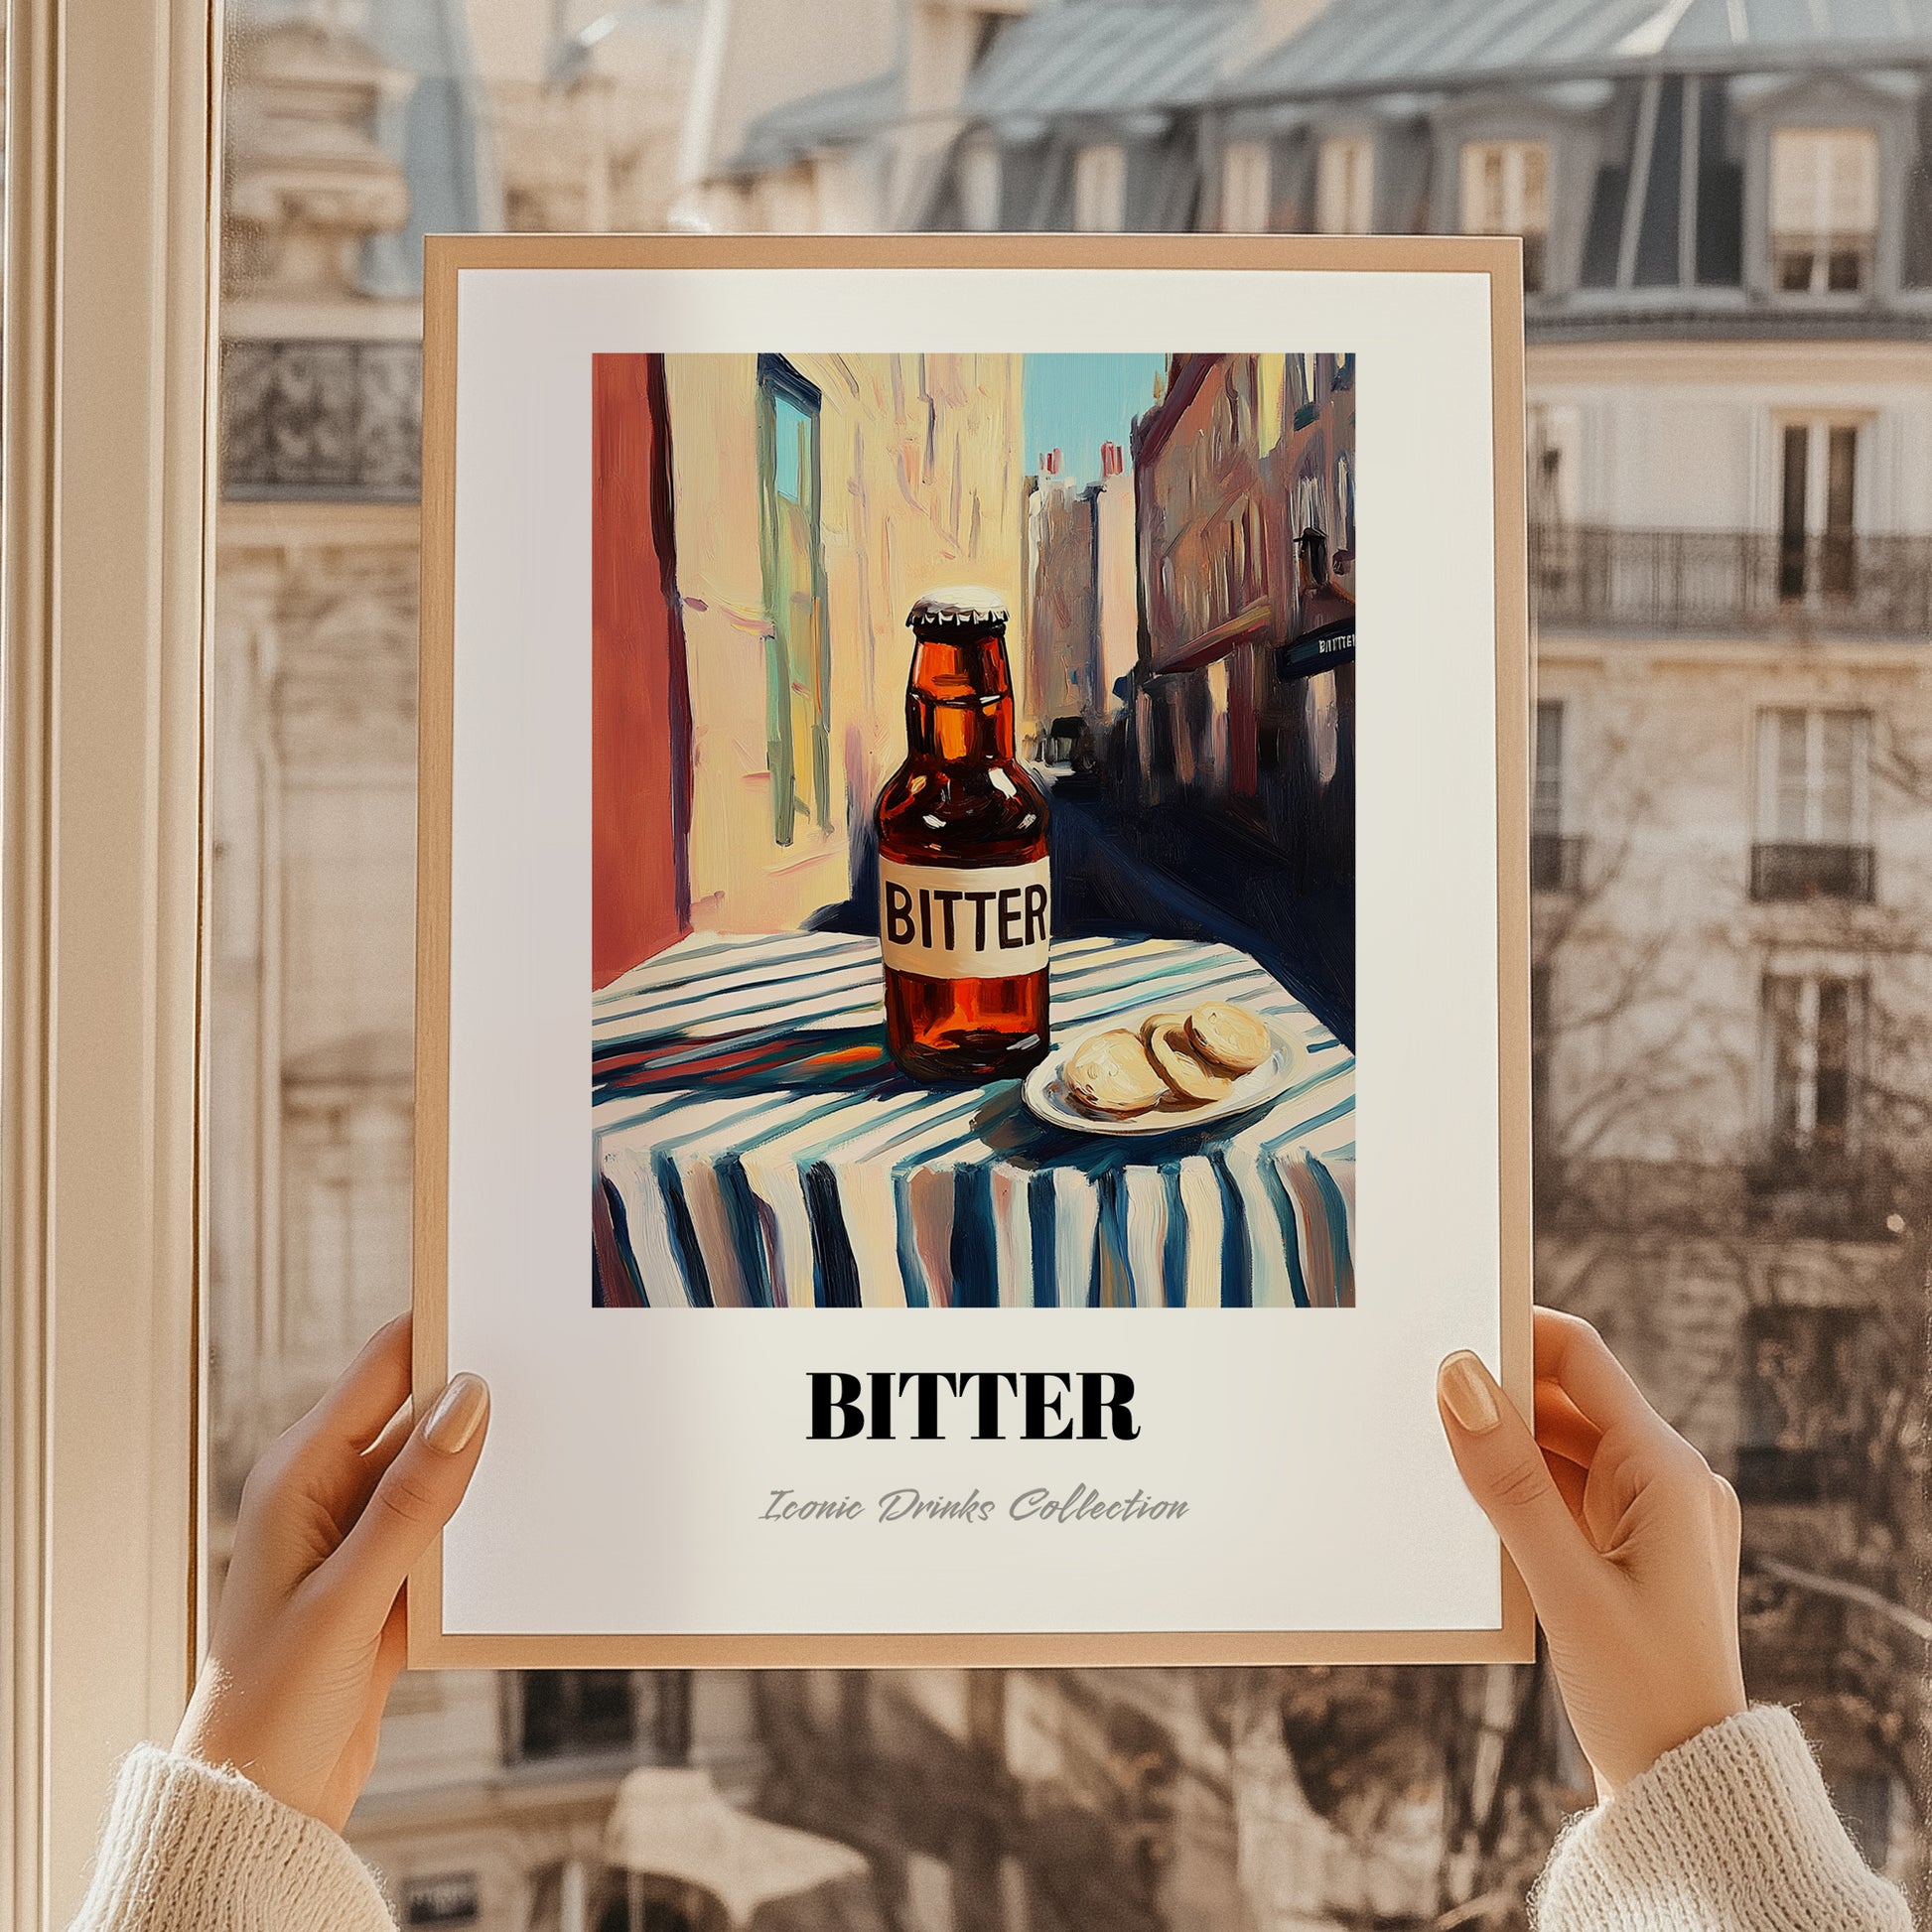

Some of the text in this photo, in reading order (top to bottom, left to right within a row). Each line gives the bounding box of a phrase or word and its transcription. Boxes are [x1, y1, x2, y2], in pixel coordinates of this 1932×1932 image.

[886, 881, 1047, 951] BITTER
[806, 1372, 1141, 1441] BITTER
[759, 1482, 1190, 1523] Iconic Drinks Collection
